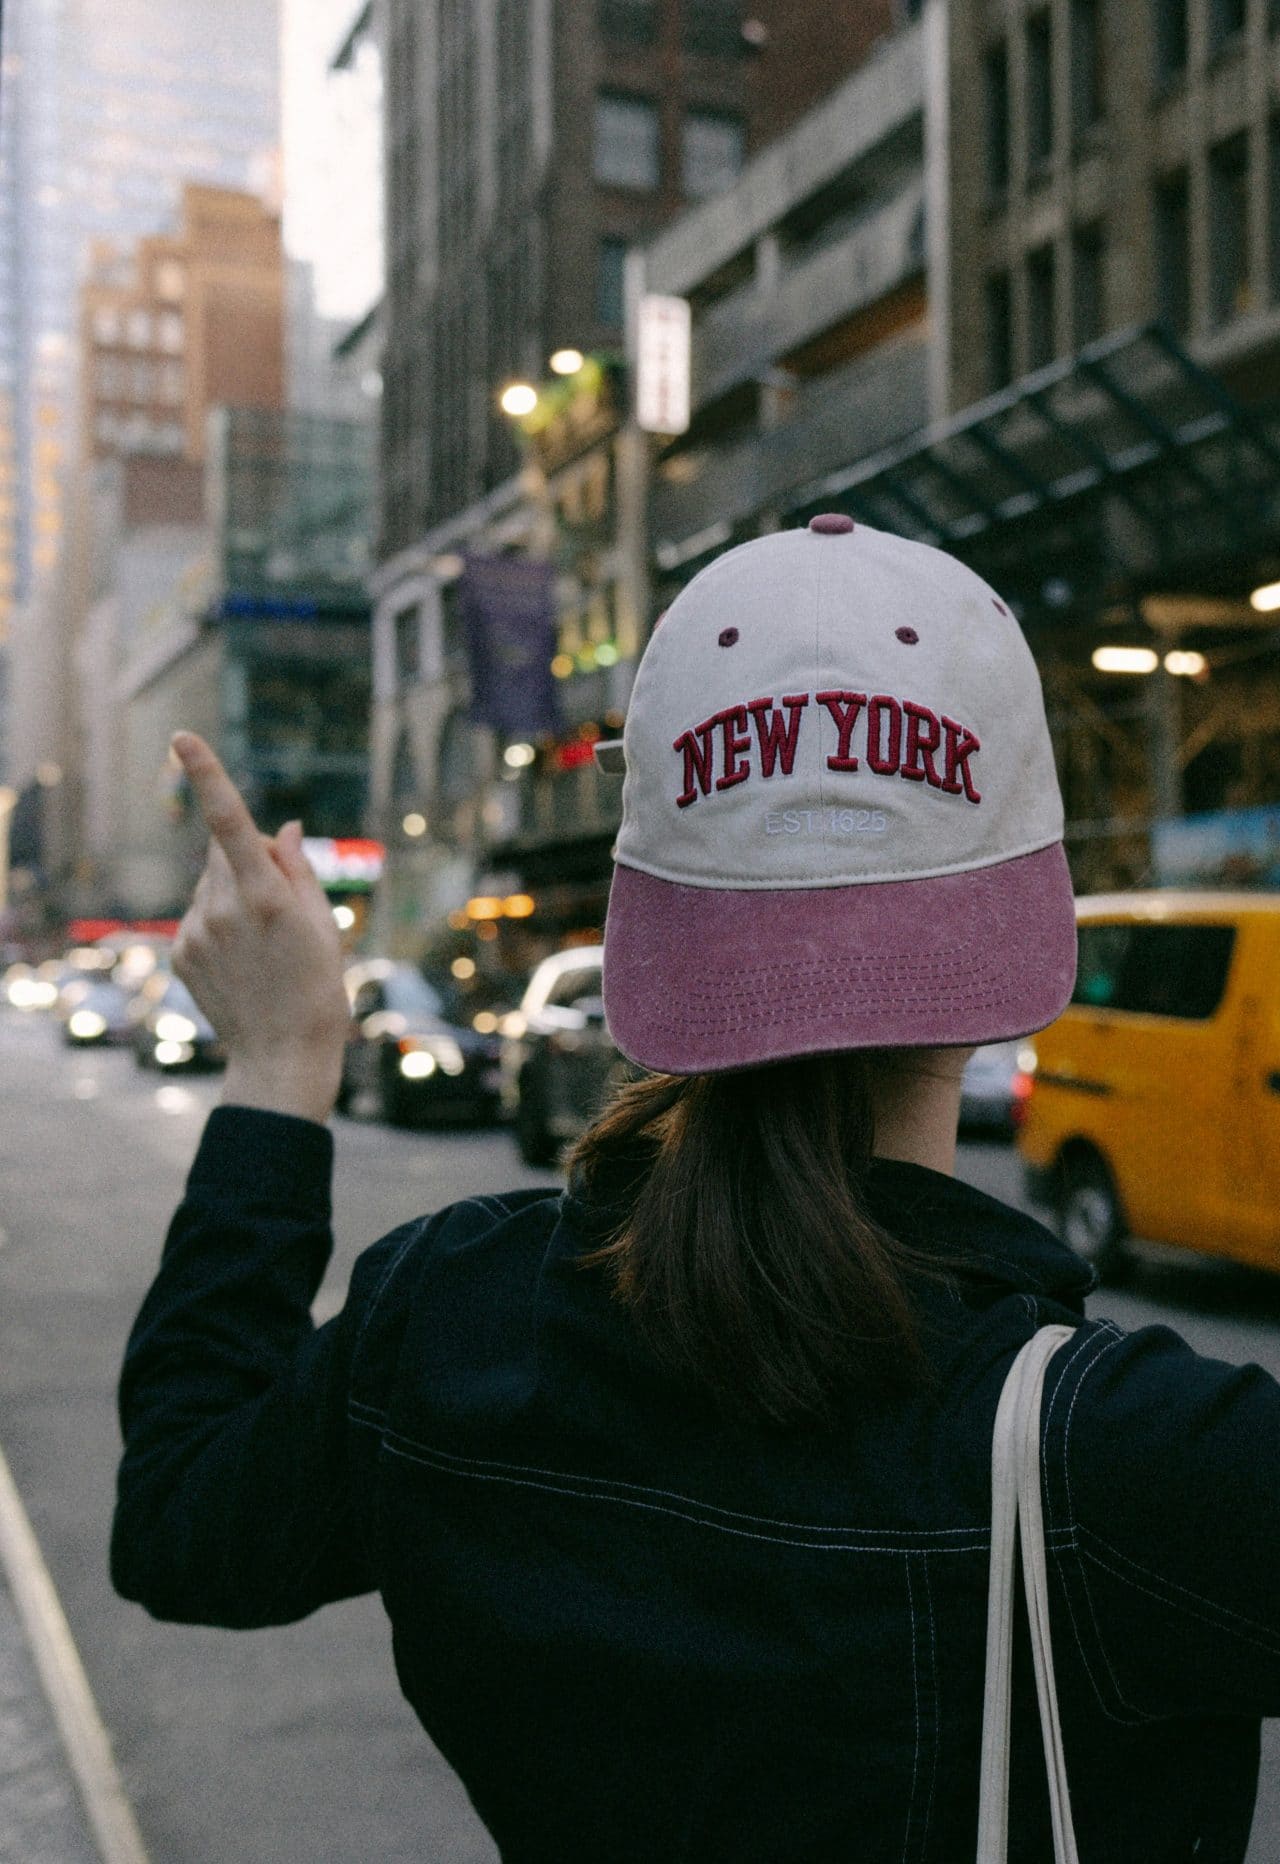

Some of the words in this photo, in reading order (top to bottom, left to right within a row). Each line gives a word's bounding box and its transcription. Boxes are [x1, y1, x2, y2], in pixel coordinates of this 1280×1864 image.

[672, 693, 809, 809] NEW
[815, 689, 981, 804] YORK
[829, 808, 888, 833] 1625
